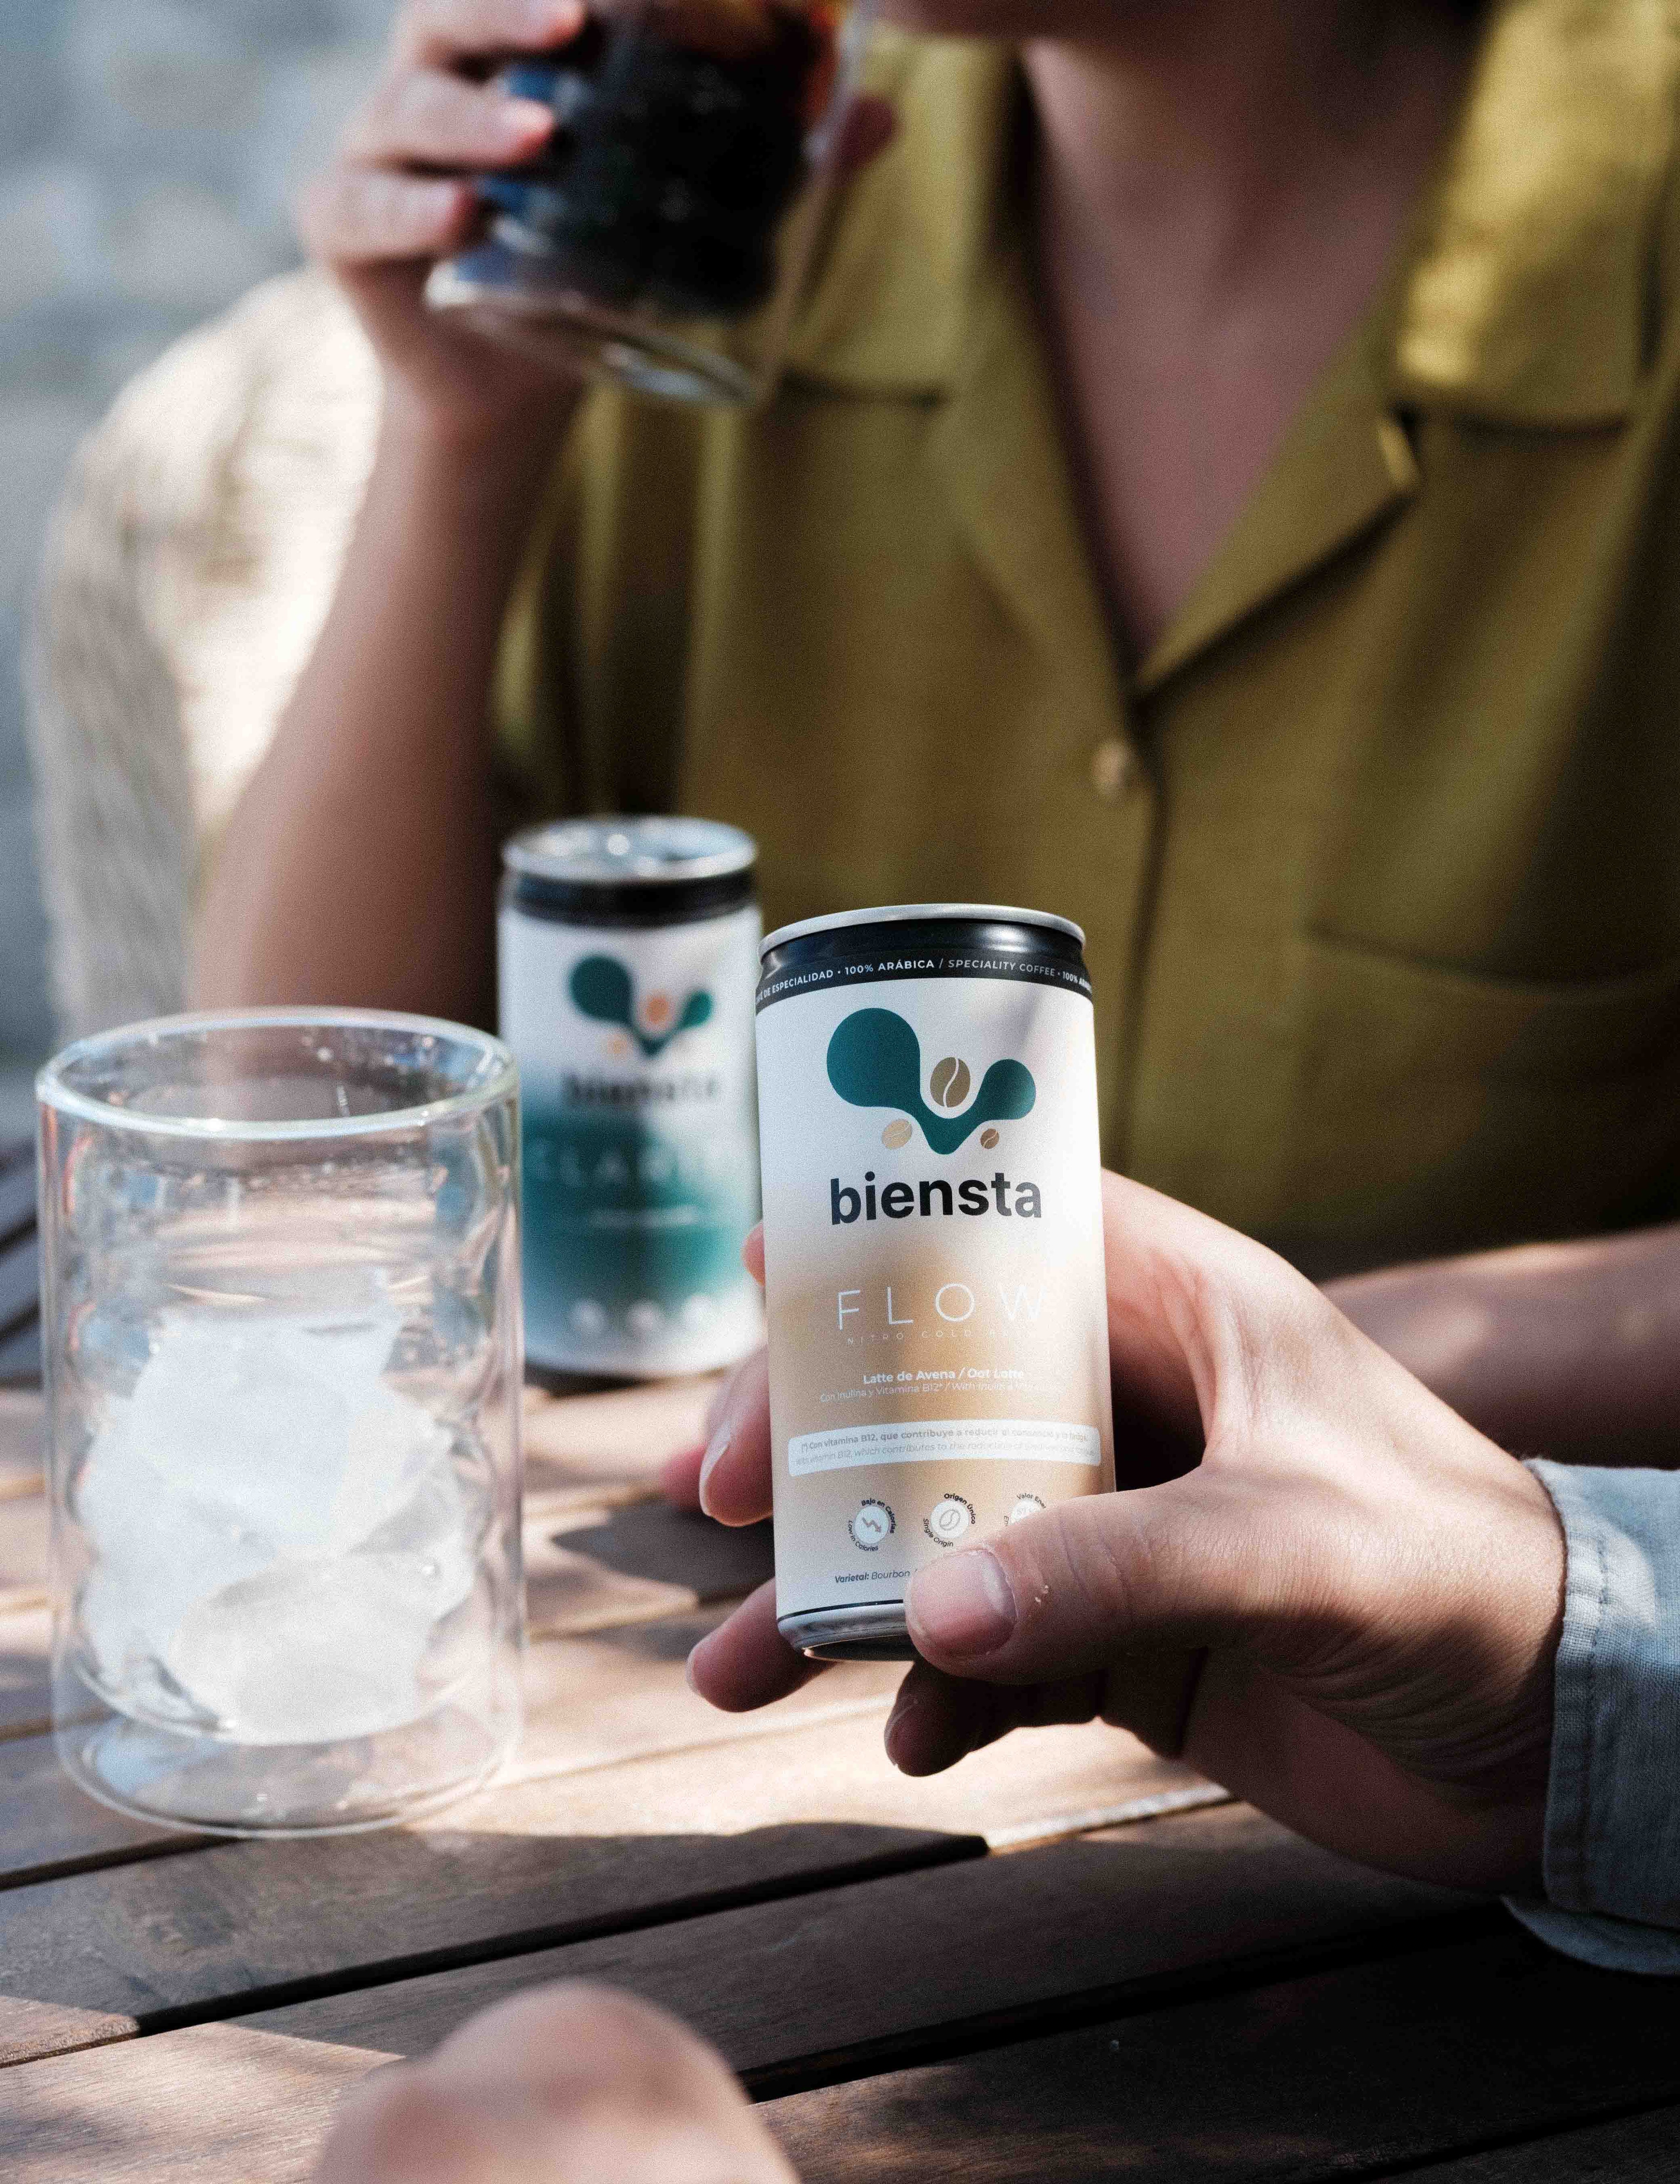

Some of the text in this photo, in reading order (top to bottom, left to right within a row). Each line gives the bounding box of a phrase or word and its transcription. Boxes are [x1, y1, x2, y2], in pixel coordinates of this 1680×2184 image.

[772, 970, 833, 993] ESPECIALIDAD
[845, 964, 873, 975] 100%
[878, 959, 934, 971] ARÁBICA
[948, 959, 1016, 971] SPECIALITY
[1019, 964, 1055, 976] COFFEE
[831, 1171, 1042, 1225] biensta
[837, 1282, 1047, 1330] FLOW
[863, 1373, 893, 1384] Latte
[897, 1371, 913, 1382] de
[916, 1370, 956, 1381] Avena
[876, 1384, 919, 1395] Vitamina
[824, 1436, 858, 1447] vitamina
[881, 1432, 898, 1441] que
[901, 1429, 954, 1439] contribuye
[861, 1498, 876, 1506] Bajo
[944, 1493, 967, 1505] Origen
[923, 1518, 954, 1548] Single Origin
[855, 1541, 878, 1551] Calories
[835, 1570, 910, 1583] Varietal: Bourbon
